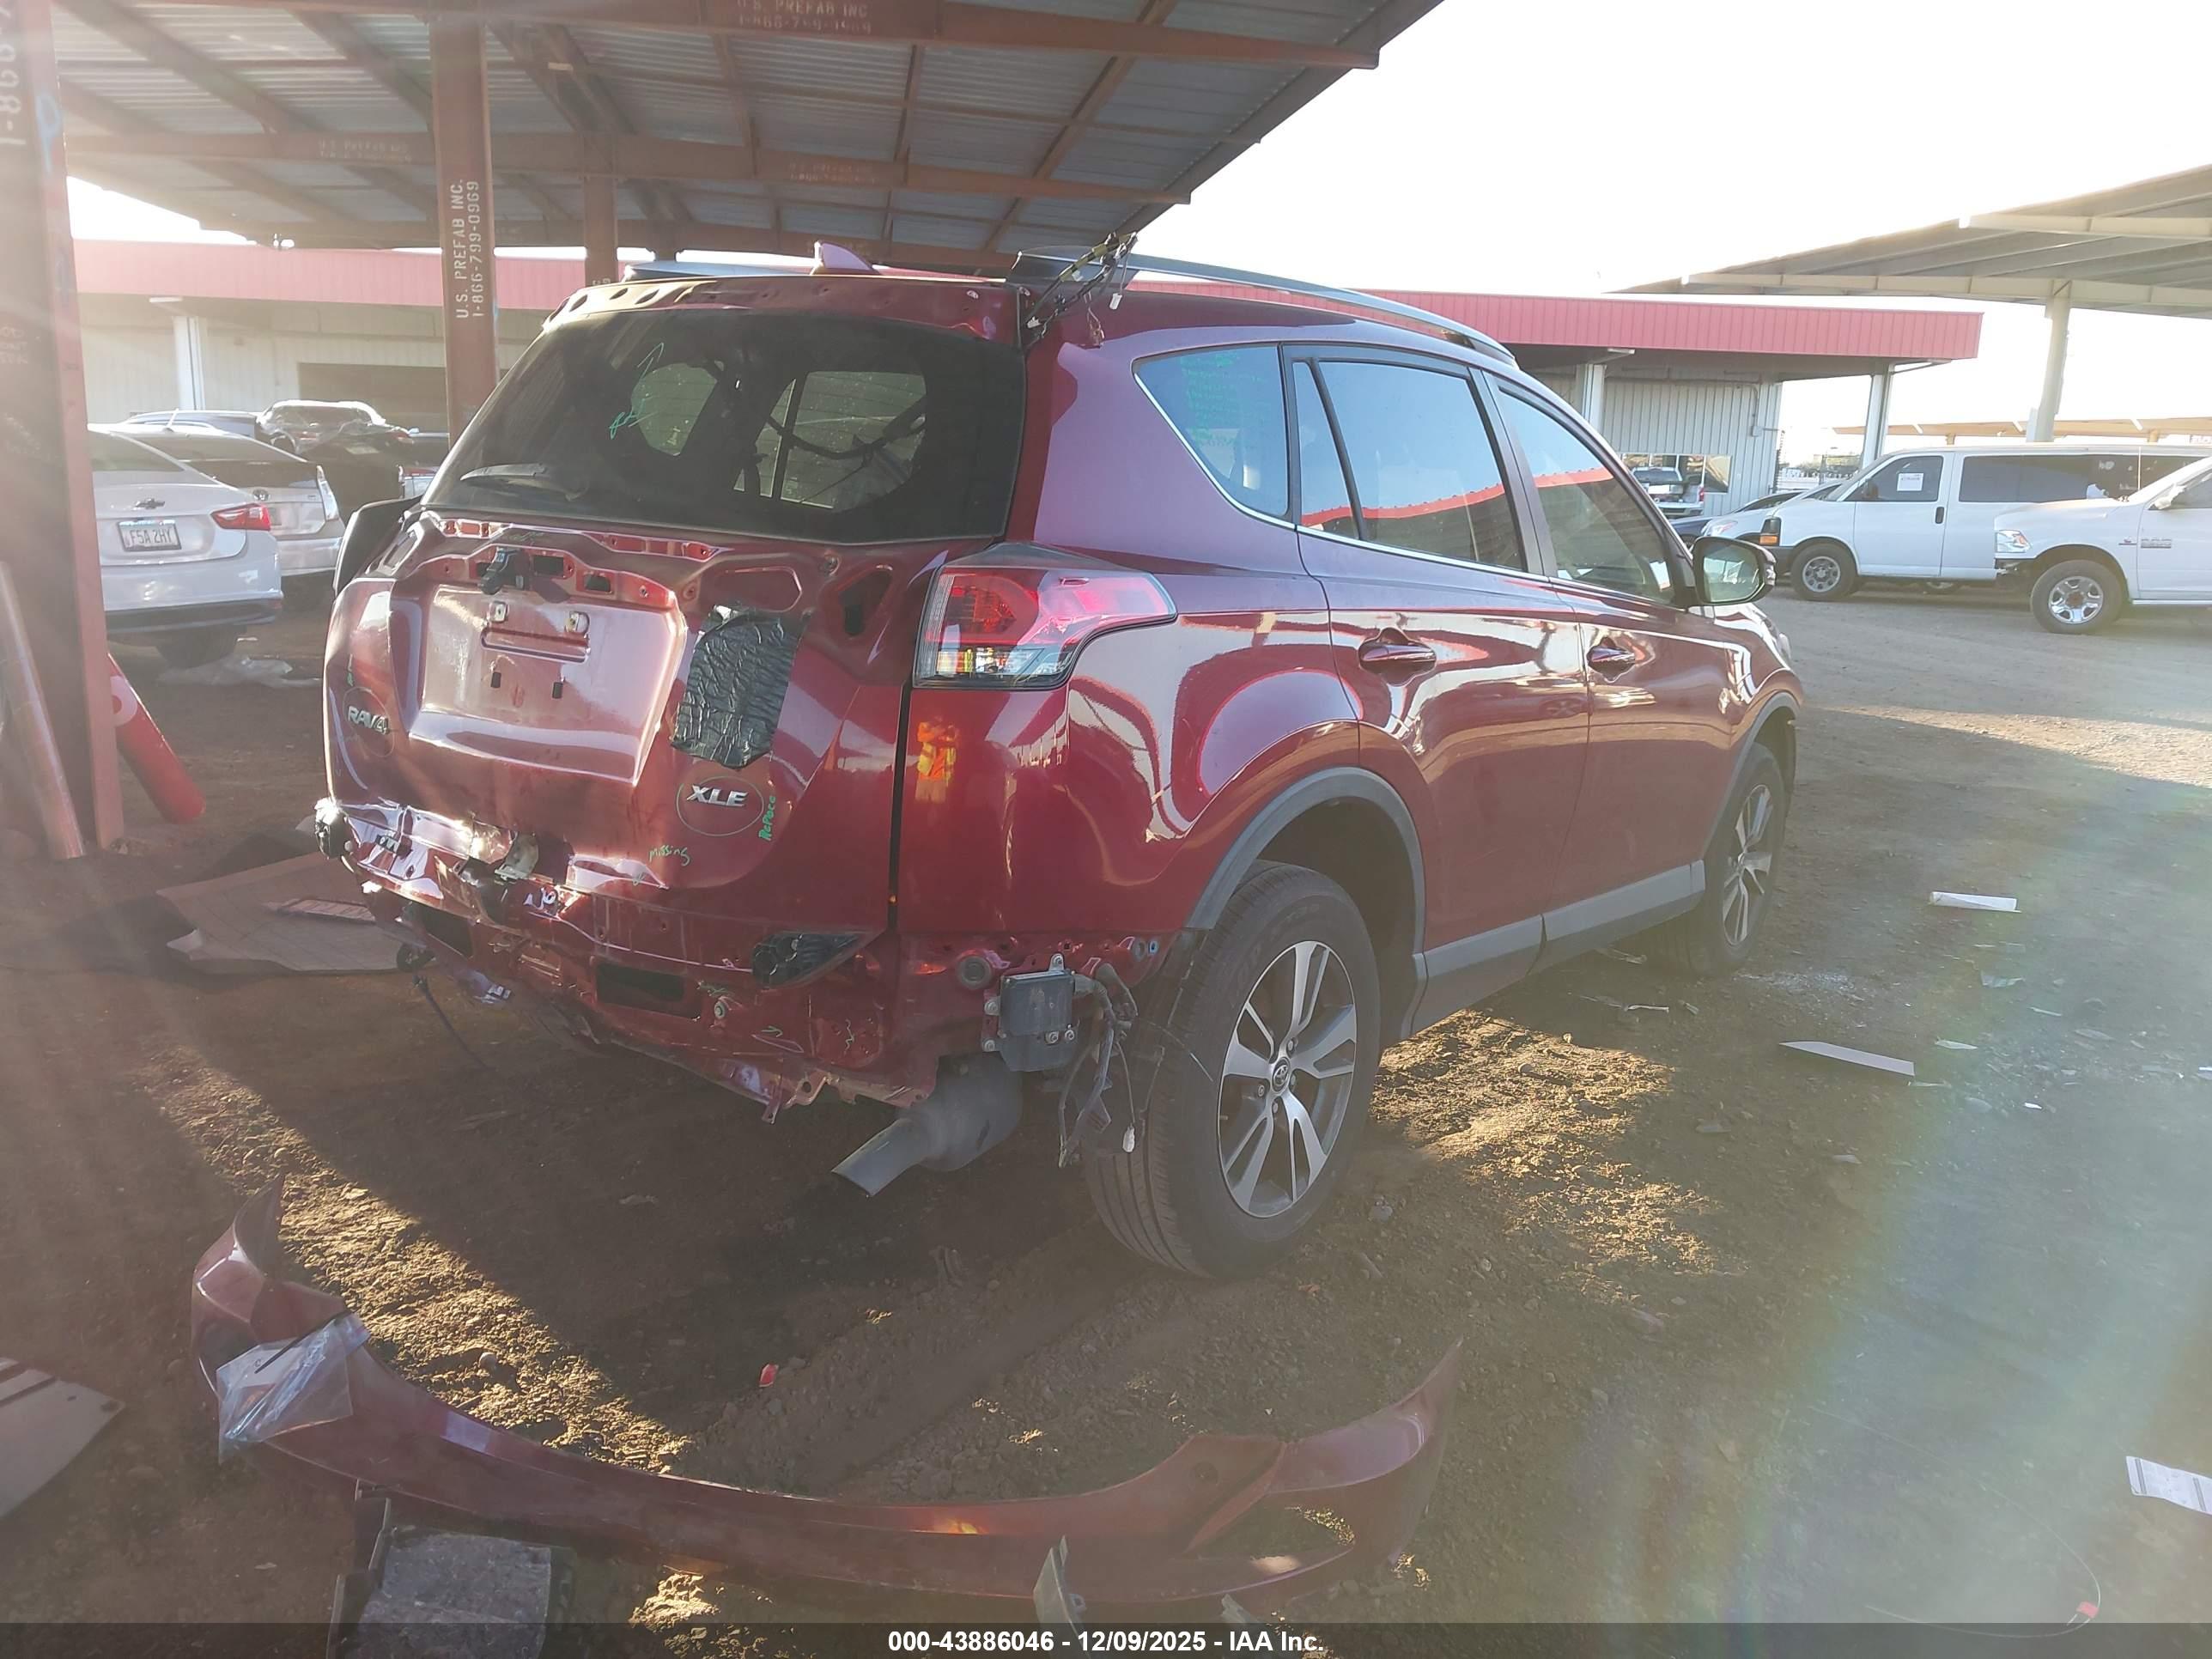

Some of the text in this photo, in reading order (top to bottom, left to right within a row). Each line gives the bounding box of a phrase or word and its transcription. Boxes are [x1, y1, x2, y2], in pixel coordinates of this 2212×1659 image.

[450, 179, 470, 319] U.S. PREFAB INC.
[466, 181, 485, 317] 1-866-799-0969
[348, 706, 389, 735] RAV4
[687, 785, 749, 807] XLE
